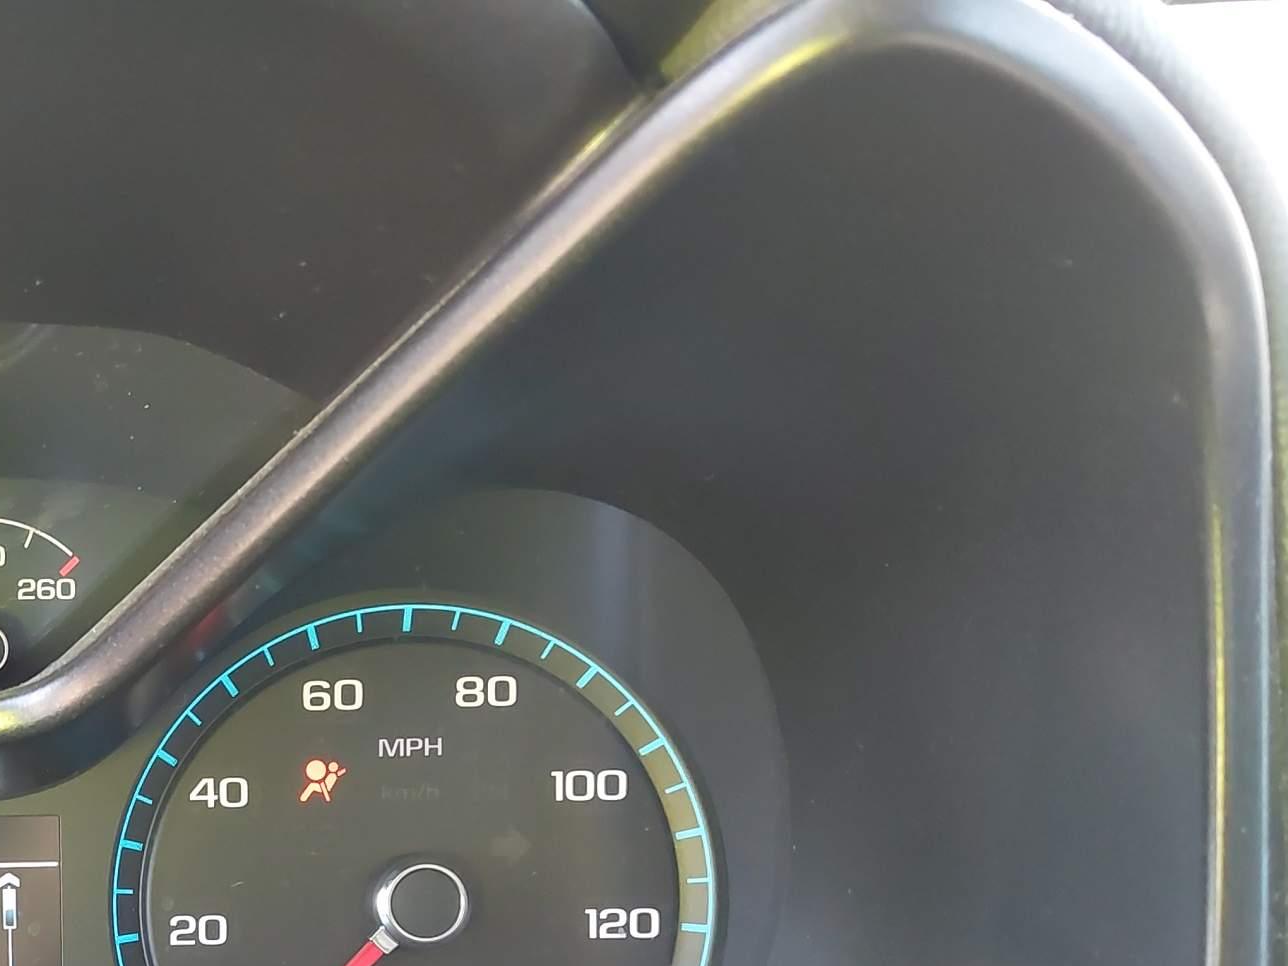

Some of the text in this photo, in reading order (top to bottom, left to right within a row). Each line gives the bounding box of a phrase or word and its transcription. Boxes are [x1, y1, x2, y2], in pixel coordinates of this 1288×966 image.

[17, 578, 76, 600] 260
[302, 679, 363, 711] 60
[455, 675, 517, 707] 80
[378, 737, 442, 758] MPH
[189, 777, 249, 808] 40
[550, 769, 627, 802] 100
[169, 914, 228, 946] 20
[584, 907, 660, 939] 120
